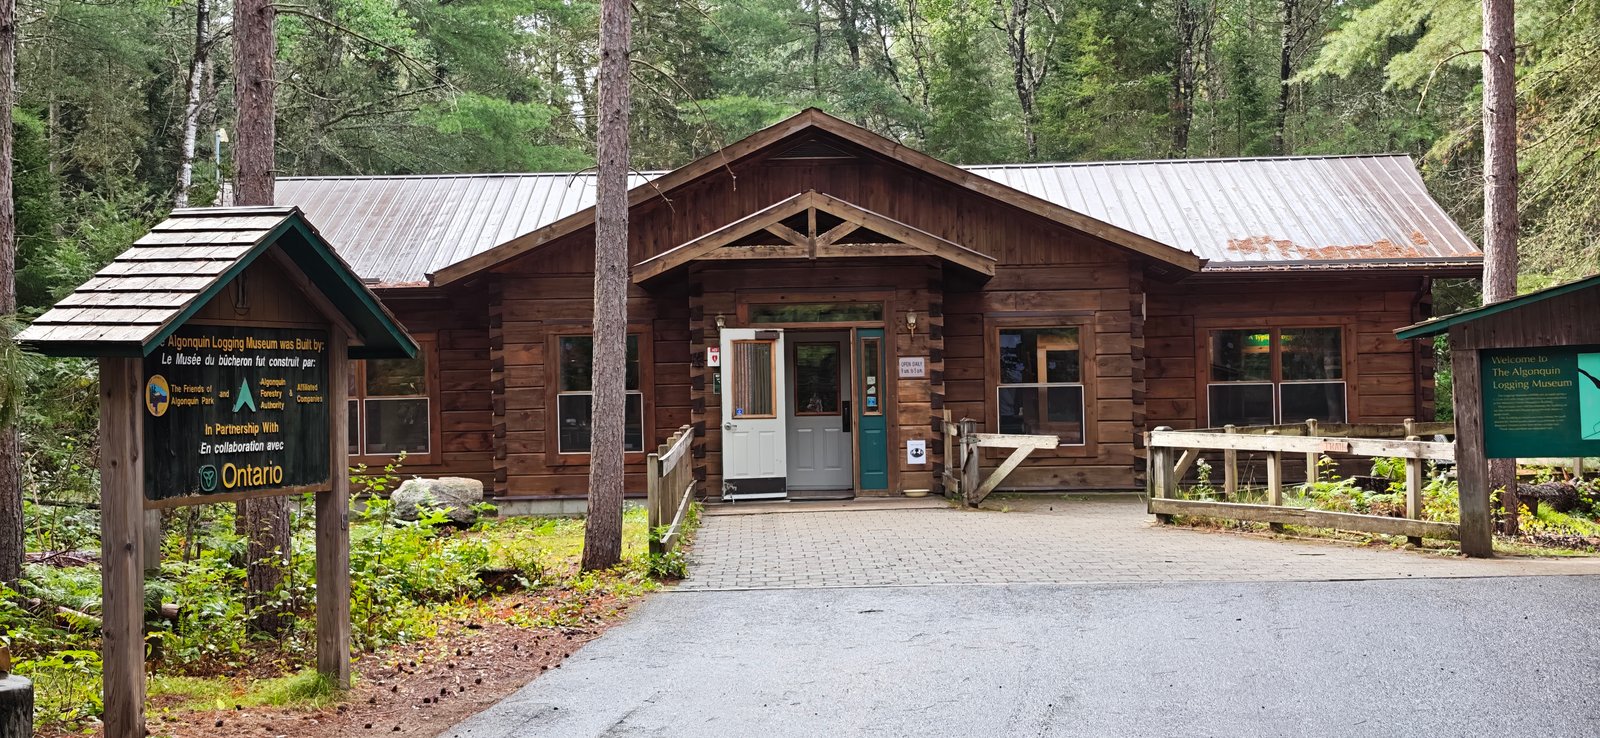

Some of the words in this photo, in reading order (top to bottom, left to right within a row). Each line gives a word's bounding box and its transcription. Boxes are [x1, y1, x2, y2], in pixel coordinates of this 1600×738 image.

[167, 334, 211, 351] Algonquin
[212, 335, 244, 352] Logging
[246, 336, 278, 350] Museum
[280, 340, 294, 350] was
[295, 338, 312, 350] Built
[313, 338, 325, 353] by:
[161, 352, 172, 365] Le
[175, 353, 201, 365] Musée
[204, 354, 215, 366] du
[218, 354, 253, 367] bûcheron
[255, 355, 266, 367] fut
[268, 356, 300, 367] construit
[302, 358, 316, 370] par:
[1492, 356, 1536, 364] Welcome
[1538, 355, 1548, 363] to
[1492, 368, 1510, 377] The
[1512, 367, 1561, 377] Algonquin
[260, 377, 286, 387] Algonquin
[1493, 380, 1529, 390] Logging
[1532, 379, 1573, 388] Museum
[171, 384, 182, 393] The
[183, 384, 205, 393] Friends
[206, 384, 213, 393] of
[219, 390, 230, 398] and
[260, 389, 282, 399] Forestry
[171, 396, 199, 407] Algonquin
[201, 396, 214, 405] Park
[297, 395, 323, 404] Companies
[260, 401, 285, 411] Authority
[205, 423, 213, 435] In
[215, 422, 260, 436] Partnership
[262, 421, 279, 433] With
[200, 441, 212, 455] En
[214, 440, 265, 454] collaboration
[266, 441, 284, 451] avec
[222, 460, 283, 489] Ontario
